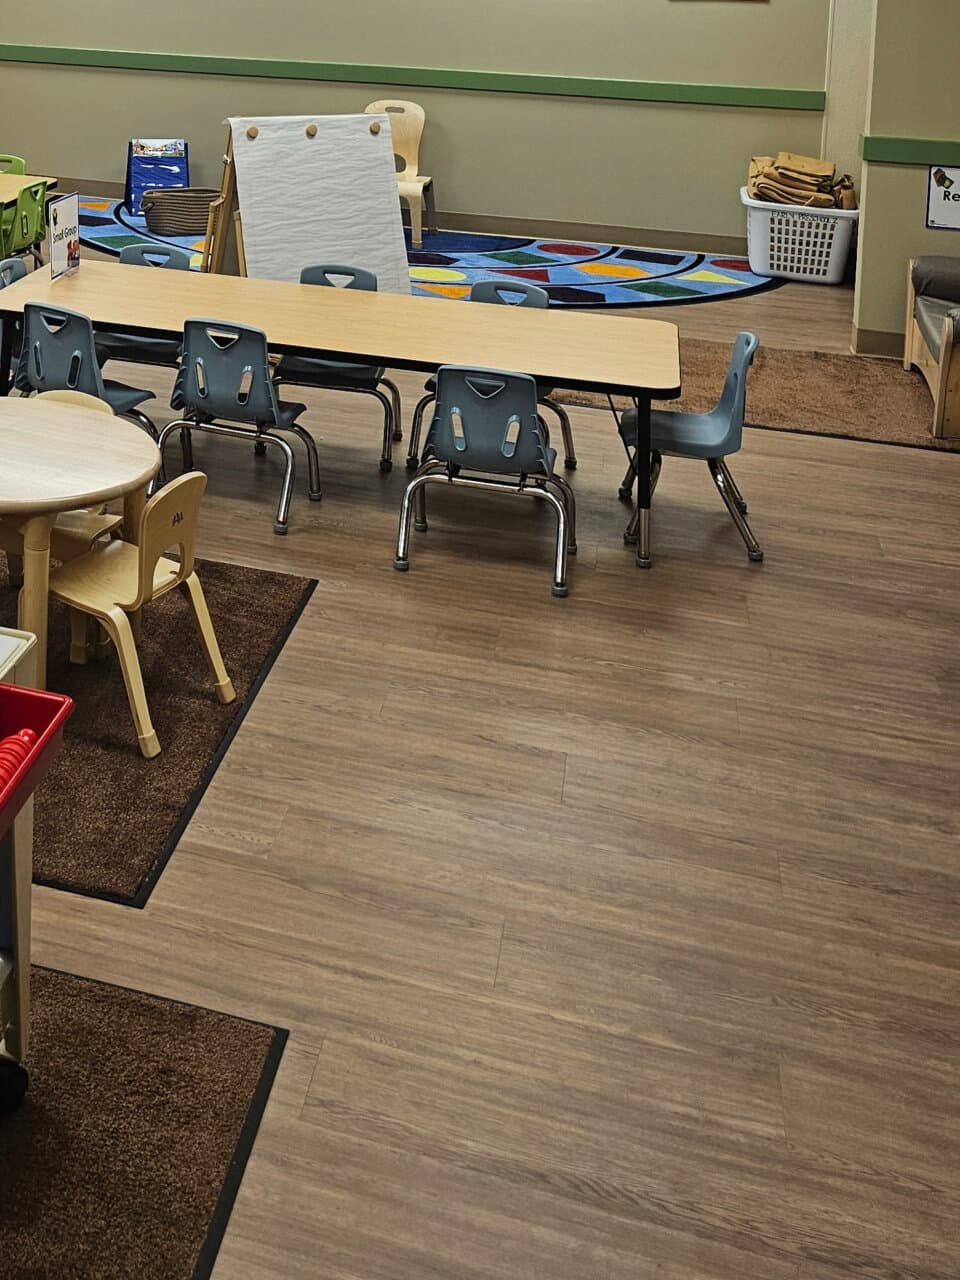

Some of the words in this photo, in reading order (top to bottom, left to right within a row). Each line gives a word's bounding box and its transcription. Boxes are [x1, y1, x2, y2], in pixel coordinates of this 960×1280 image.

[943, 190, 960, 202] Re
[52, 228, 64, 244] Small
[64, 224, 77, 239] Group
